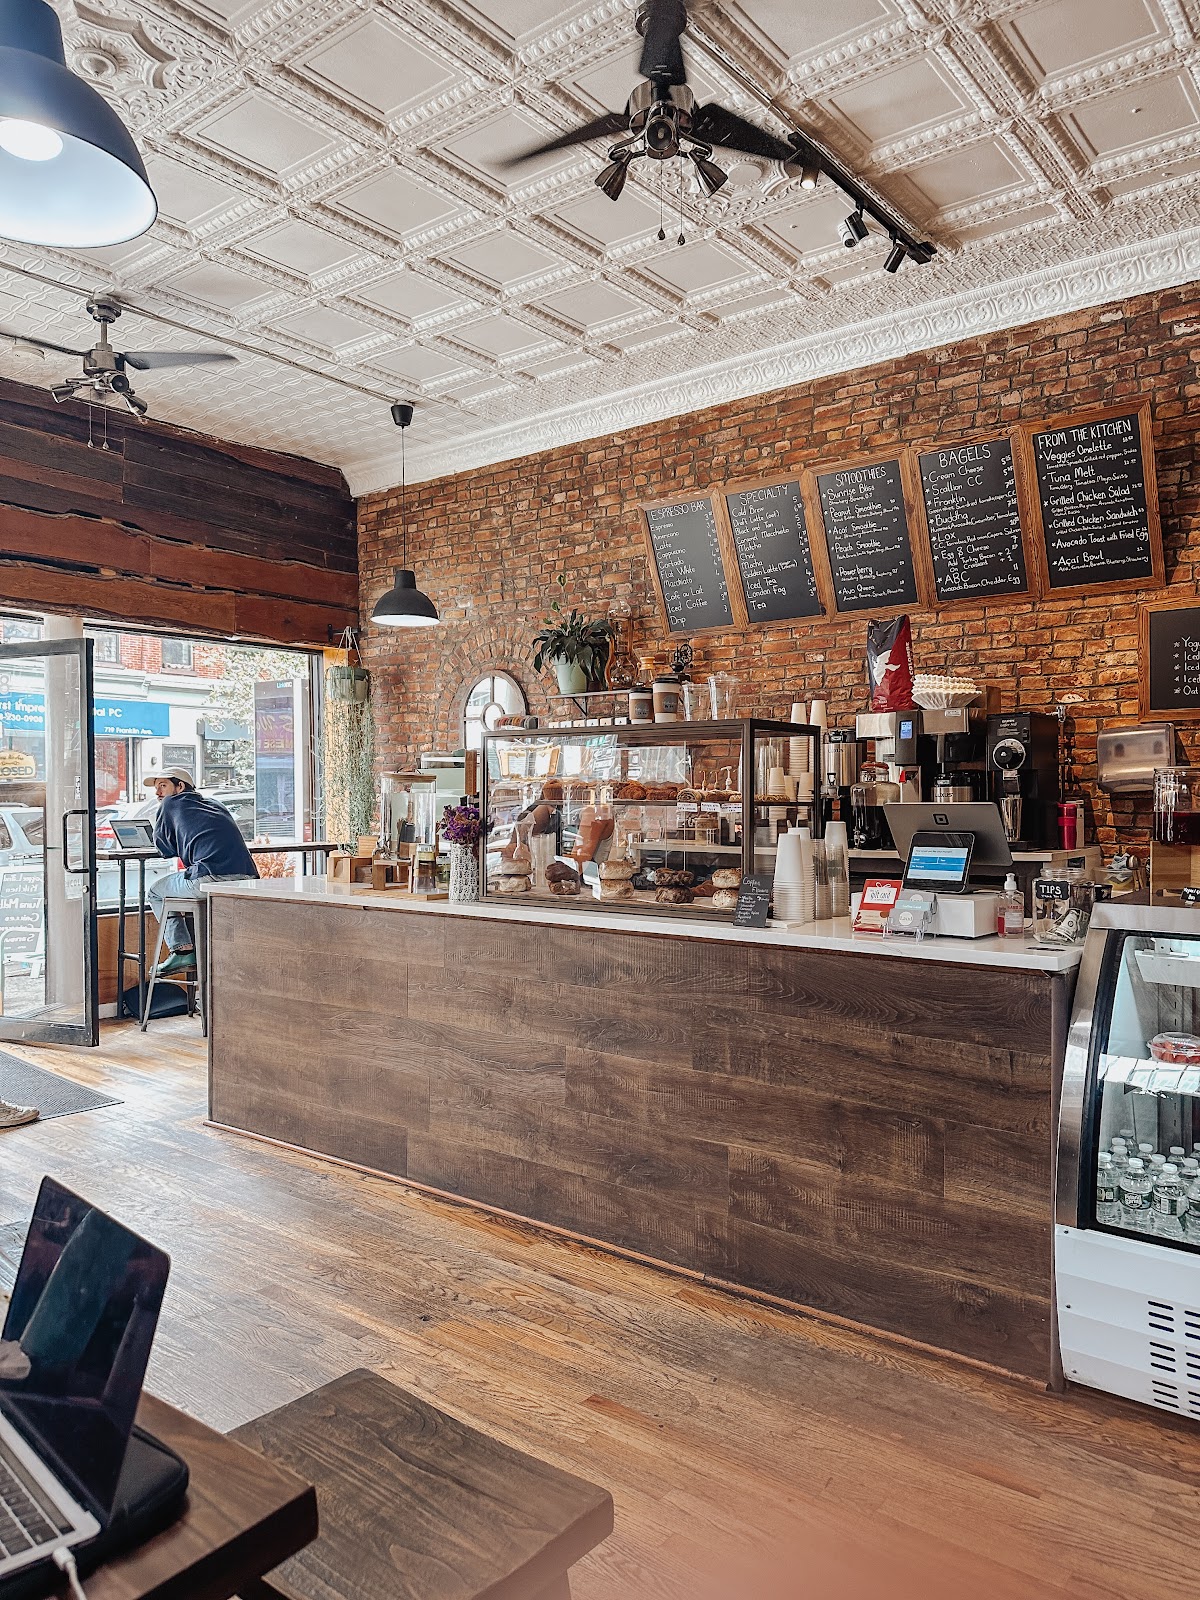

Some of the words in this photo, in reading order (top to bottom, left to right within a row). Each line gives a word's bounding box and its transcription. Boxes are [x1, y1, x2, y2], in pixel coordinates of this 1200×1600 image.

[1038, 431, 1068, 450] FROM
[1069, 426, 1089, 442] THE
[1090, 419, 1132, 440] KITCHEN
[938, 444, 991, 468] BAGELS
[1043, 448, 1076, 464] Veggies
[1076, 439, 1113, 455] Omelette
[835, 466, 887, 488] SMOOTHIES
[928, 470, 956, 483] Cream
[958, 465, 984, 476] Cheese
[1047, 471, 1071, 483] Tuna
[1074, 465, 1096, 479] Melt
[826, 488, 857, 501] Sunrise
[859, 483, 875, 494] Bliss
[931, 481, 963, 496] Scallion
[967, 474, 983, 487] CC
[739, 484, 788, 506] SPECIALTY
[933, 493, 966, 508] Franklin
[1049, 492, 1075, 506] Grilled
[1076, 488, 1106, 502] Chicken
[1108, 484, 1130, 498] Salad
[650, 503, 690, 521] ESPRESSO
[690, 500, 707, 512] BAR
[732, 505, 746, 517] Cold
[749, 504, 764, 515] Brew
[829, 506, 852, 519] Peanut
[855, 502, 882, 514] Smoothie
[1053, 517, 1076, 529] Grilled
[1076, 513, 1105, 525] Chicken
[1105, 505, 1139, 520] Sandwich
[749, 514, 764, 524] Latte
[763, 520, 774, 529] Tan
[851, 520, 877, 531] Smoothie
[935, 510, 969, 527] Buddha
[650, 522, 674, 532] Espresso
[761, 524, 790, 539] Macchiato
[937, 532, 957, 543] Lox
[1056, 535, 1088, 549] Avocado
[1088, 532, 1106, 544] Toast
[1106, 532, 1119, 541] with
[1119, 529, 1135, 540] Fried
[1135, 528, 1149, 542] Egg
[654, 541, 672, 551] Latte
[738, 541, 762, 552] Matcha
[834, 542, 853, 553] Peach
[856, 539, 881, 549] Smoothie
[740, 553, 755, 561] Chai
[941, 549, 955, 560] Egg
[1082, 550, 1104, 563] Bowl
[658, 557, 685, 569] Cortado
[741, 558, 763, 570] Mocha
[660, 569, 674, 580] Flat
[676, 565, 696, 576] White
[743, 568, 763, 579] Golden
[944, 571, 971, 585] ABC
[746, 579, 763, 590] Iced
[763, 576, 777, 586] Tea
[842, 587, 855, 595] Avo
[856, 583, 875, 592] Queen
[746, 588, 771, 599] London
[772, 584, 787, 596] Fog
[667, 601, 682, 614] Iced
[686, 597, 708, 610] Coffee
[750, 600, 767, 610] Tea
[669, 615, 686, 627] Drip
[1183, 685, 1199, 695] Oat
[108, 708, 123, 718] PC
[1039, 884, 1062, 895] TIPS
